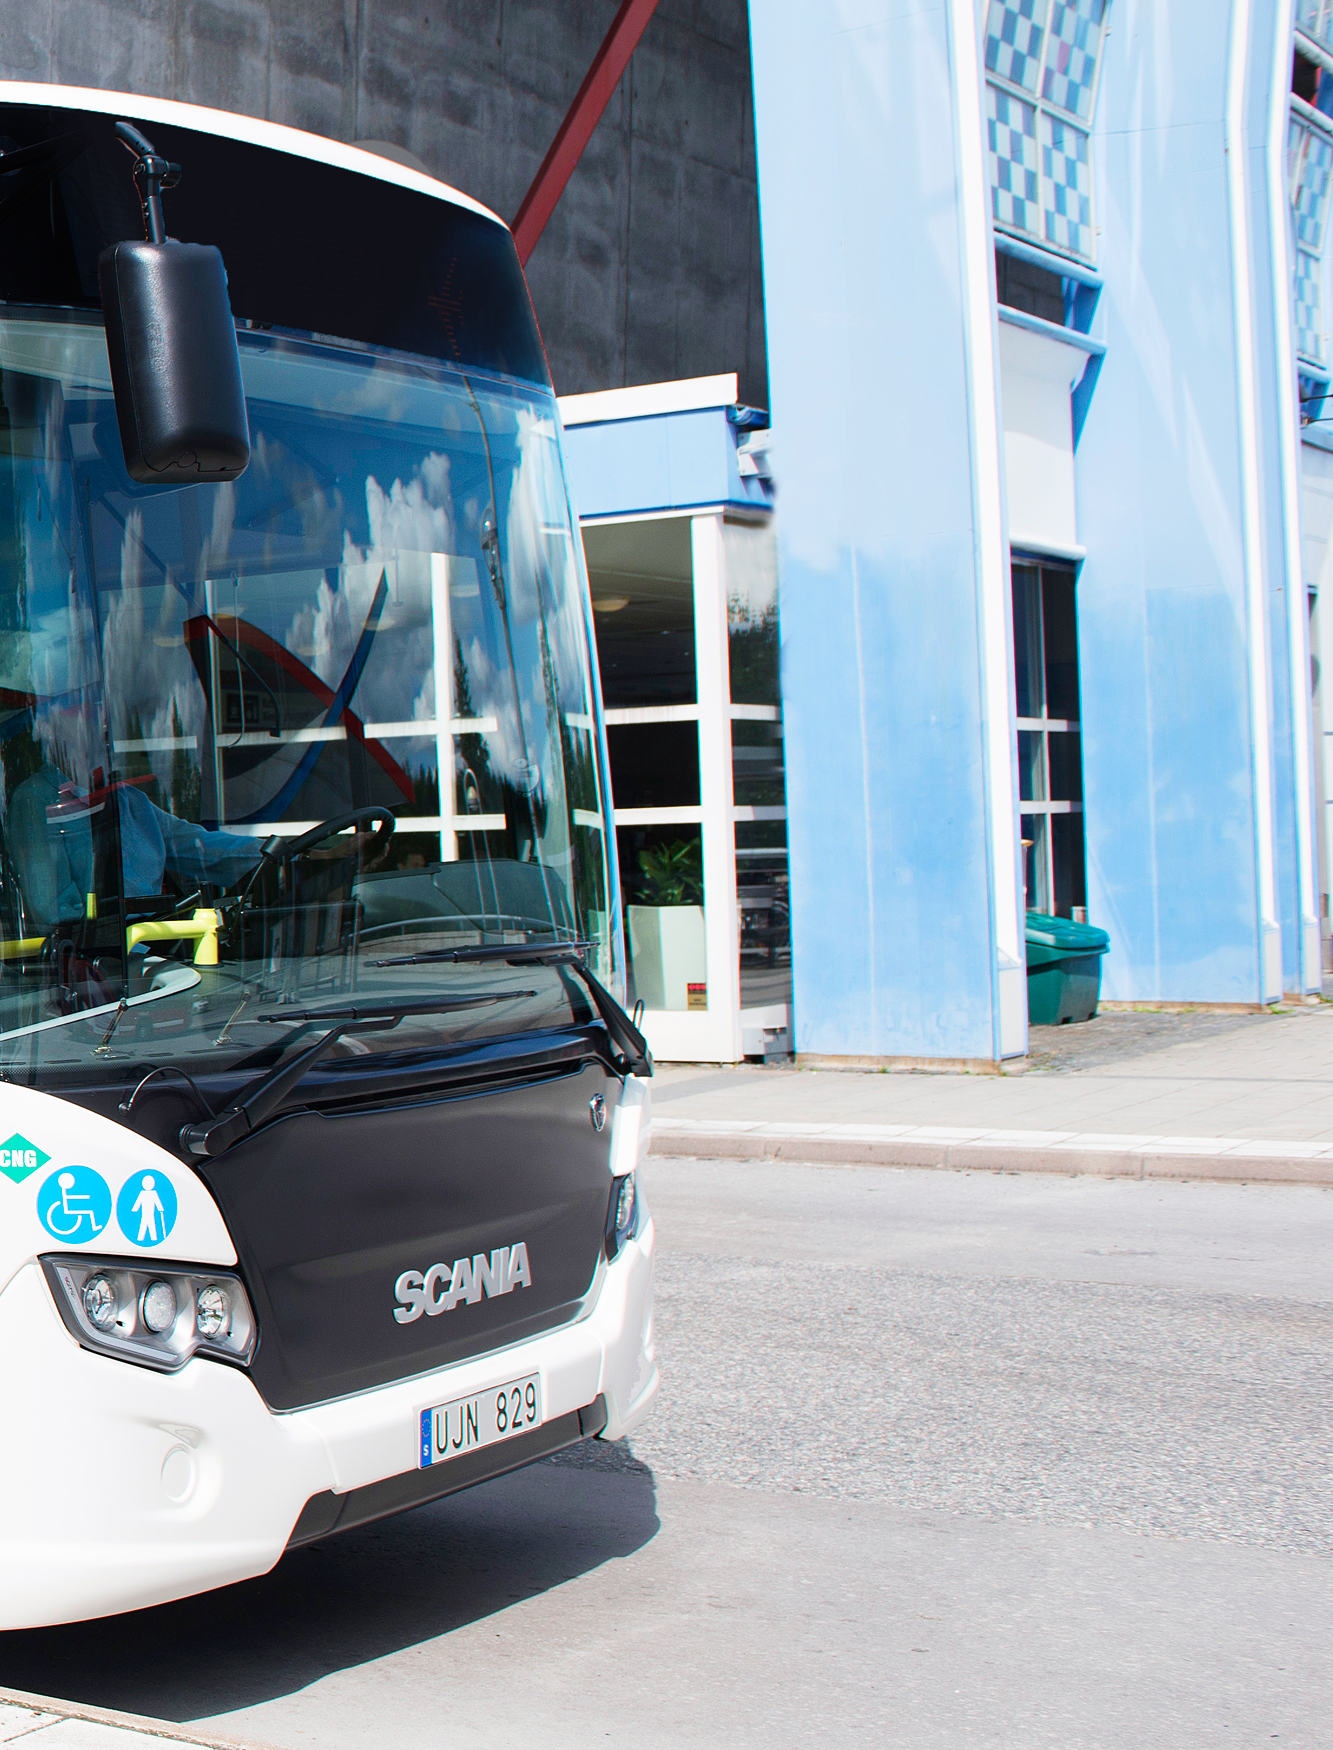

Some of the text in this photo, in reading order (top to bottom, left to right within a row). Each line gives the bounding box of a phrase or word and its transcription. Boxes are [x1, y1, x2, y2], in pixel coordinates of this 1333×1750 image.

[393, 1241, 532, 1324] SCANIA
[423, 1382, 536, 1456] S UJN 829
